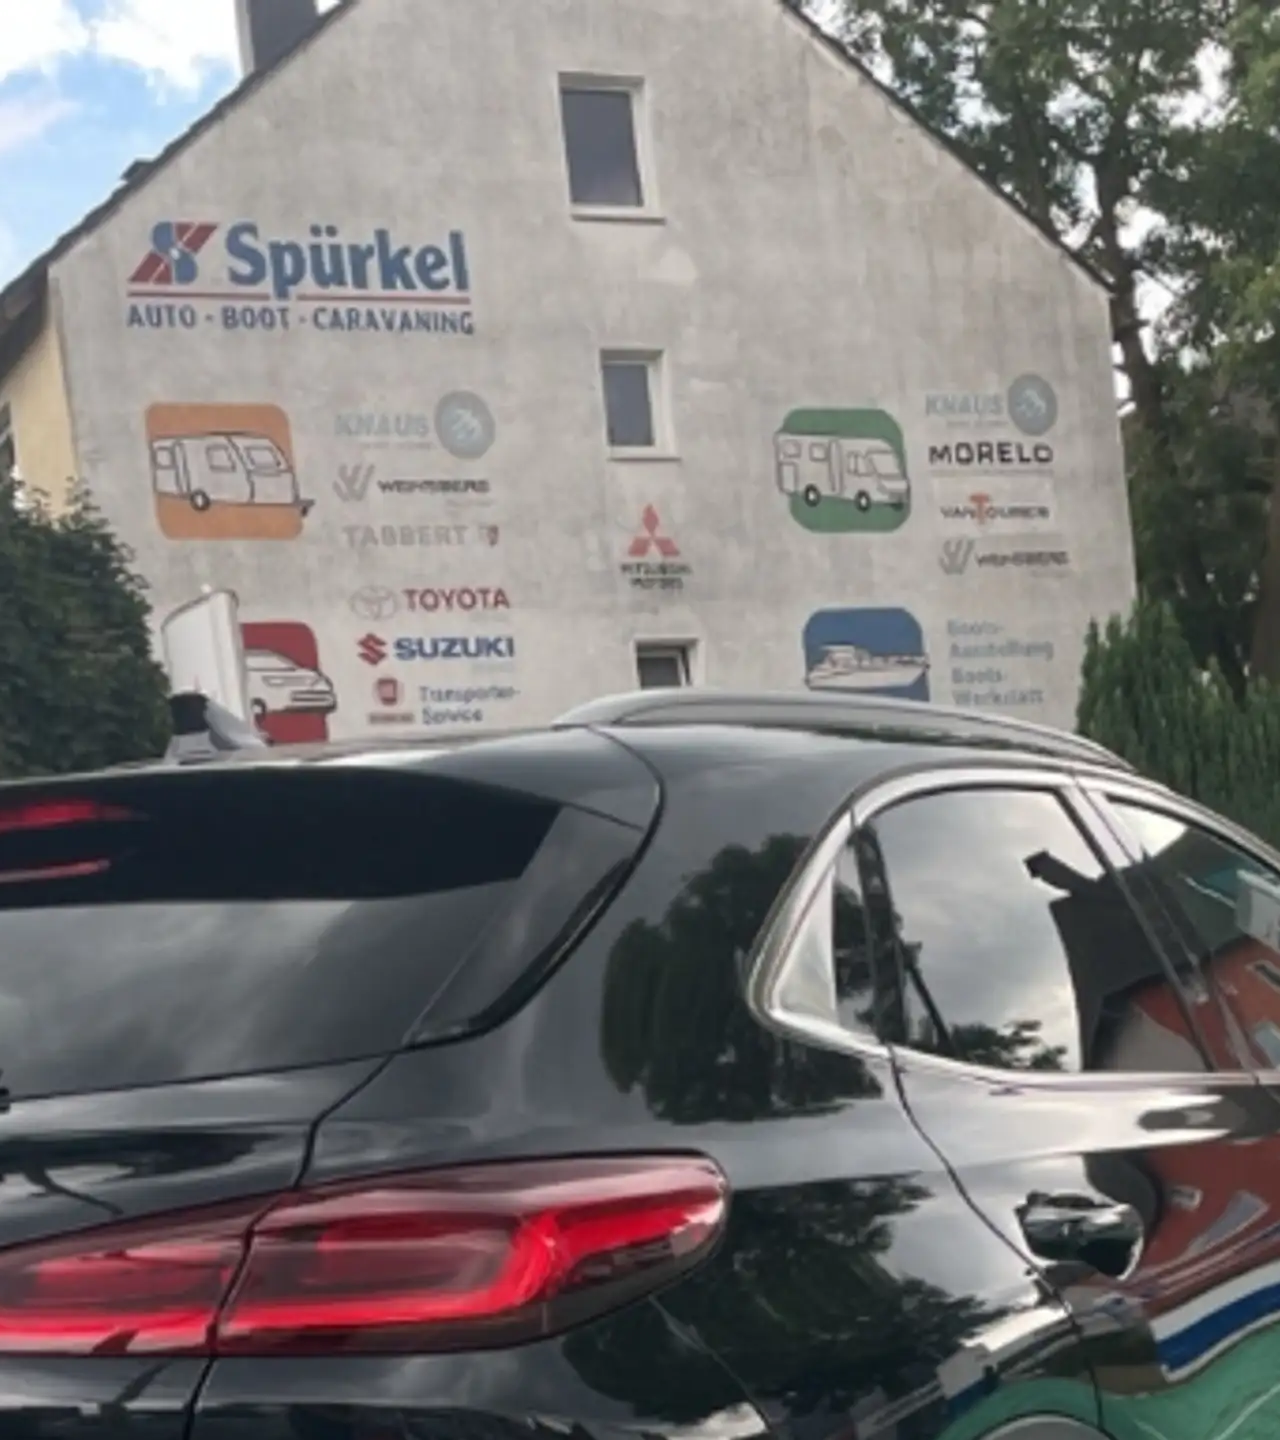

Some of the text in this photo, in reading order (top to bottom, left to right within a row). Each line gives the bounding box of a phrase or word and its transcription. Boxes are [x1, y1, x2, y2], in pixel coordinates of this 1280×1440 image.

[224, 221, 471, 299] Spürkel
[126, 305, 474, 336] AUTO BOOT CARAVANING
[924, 393, 1004, 417] KNAUS
[333, 411, 430, 437] KNAUS
[928, 441, 1054, 465] MORELO
[341, 524, 469, 549] TABBERT
[401, 587, 512, 613] TOYOTA
[392, 636, 516, 661] SUZUKI
